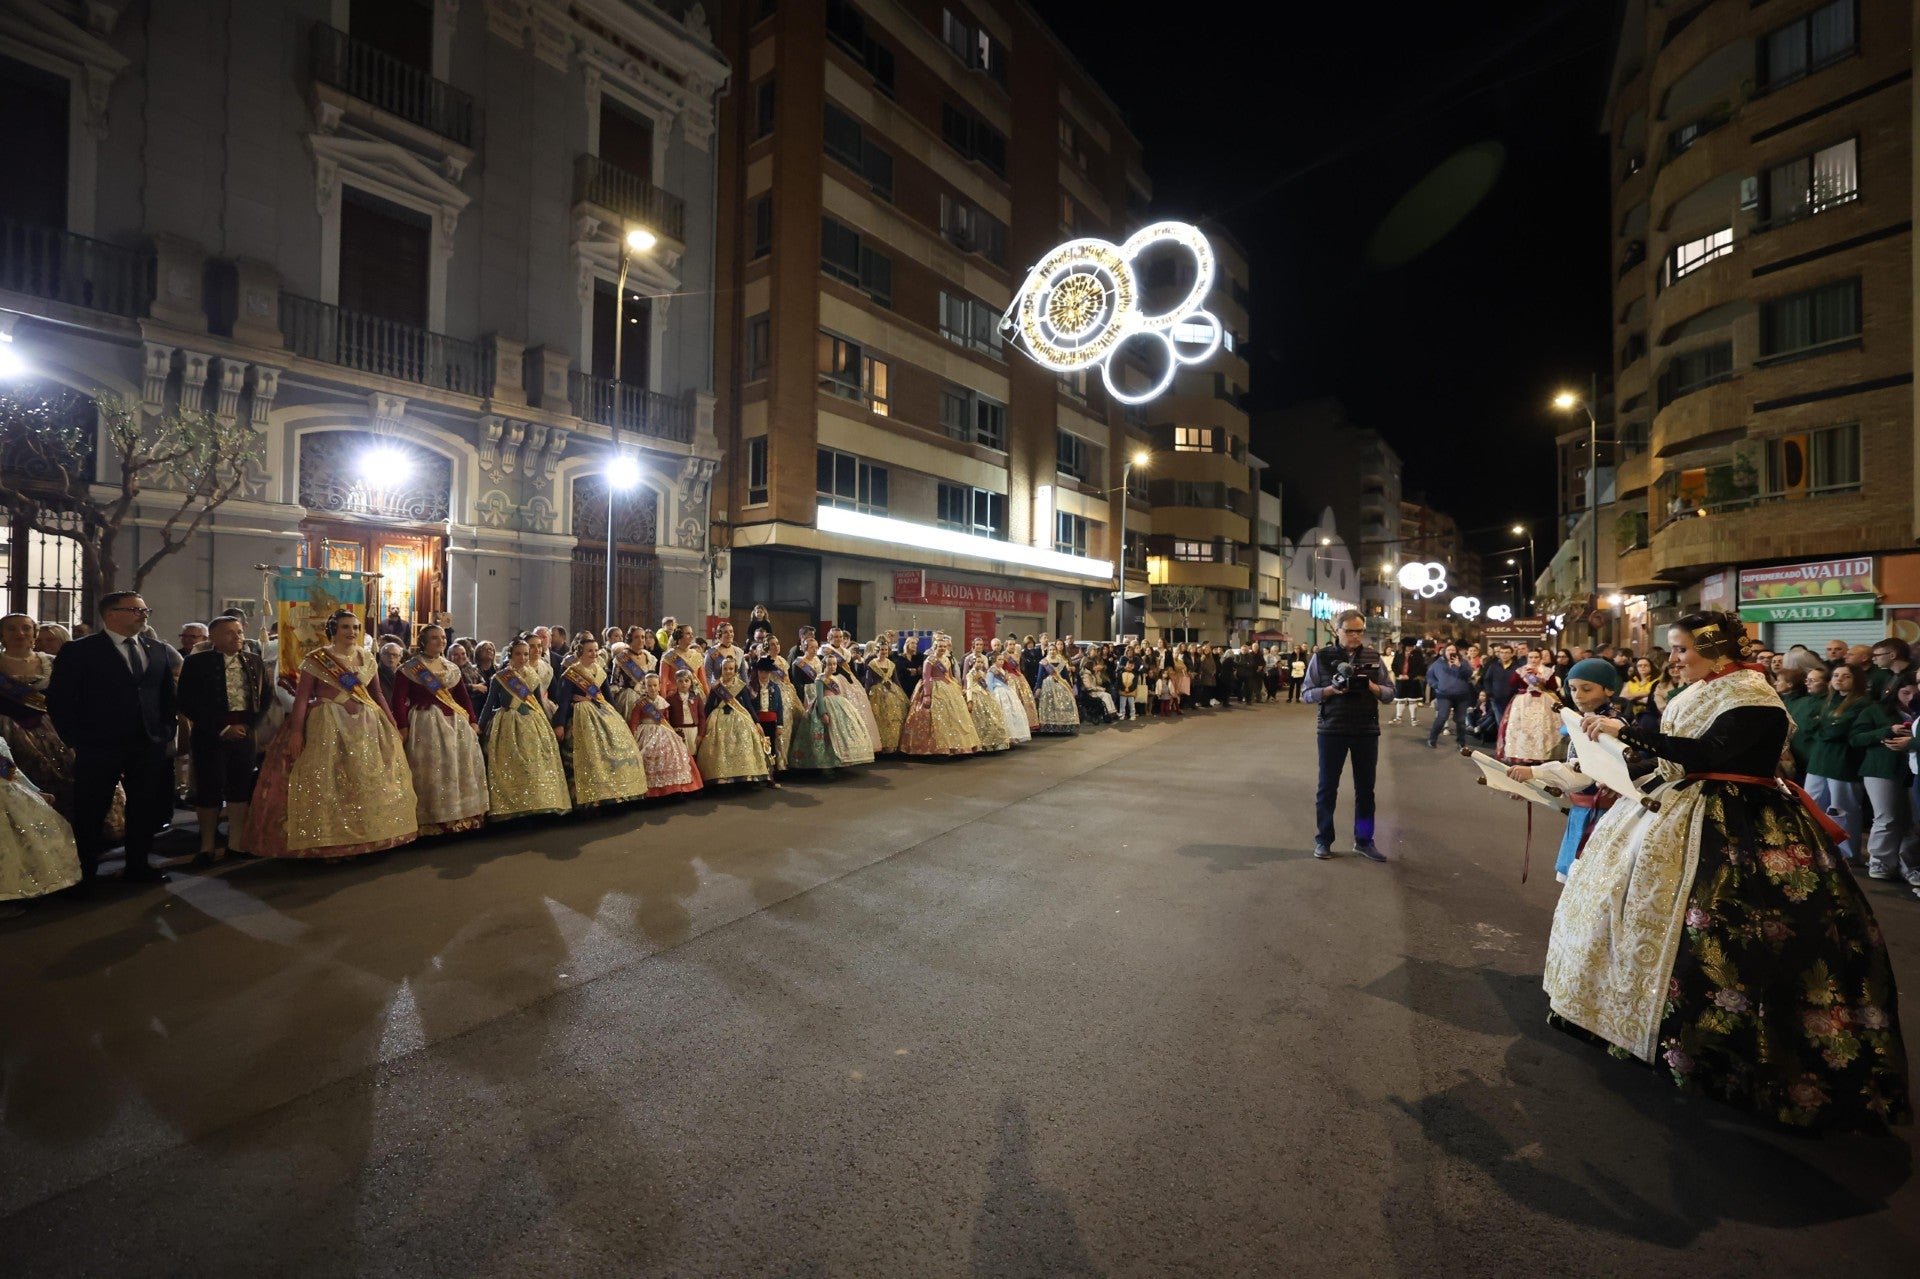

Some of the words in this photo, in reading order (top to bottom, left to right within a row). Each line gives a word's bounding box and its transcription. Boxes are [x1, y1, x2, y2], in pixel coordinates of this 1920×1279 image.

[1742, 571, 1800, 583] SUPERMERCADO
[1800, 561, 1869, 580] WALID
[942, 583, 974, 600] MODA
[976, 587, 983, 600] Y
[984, 588, 1014, 603] BAZAR
[1770, 607, 1836, 619] WALID
